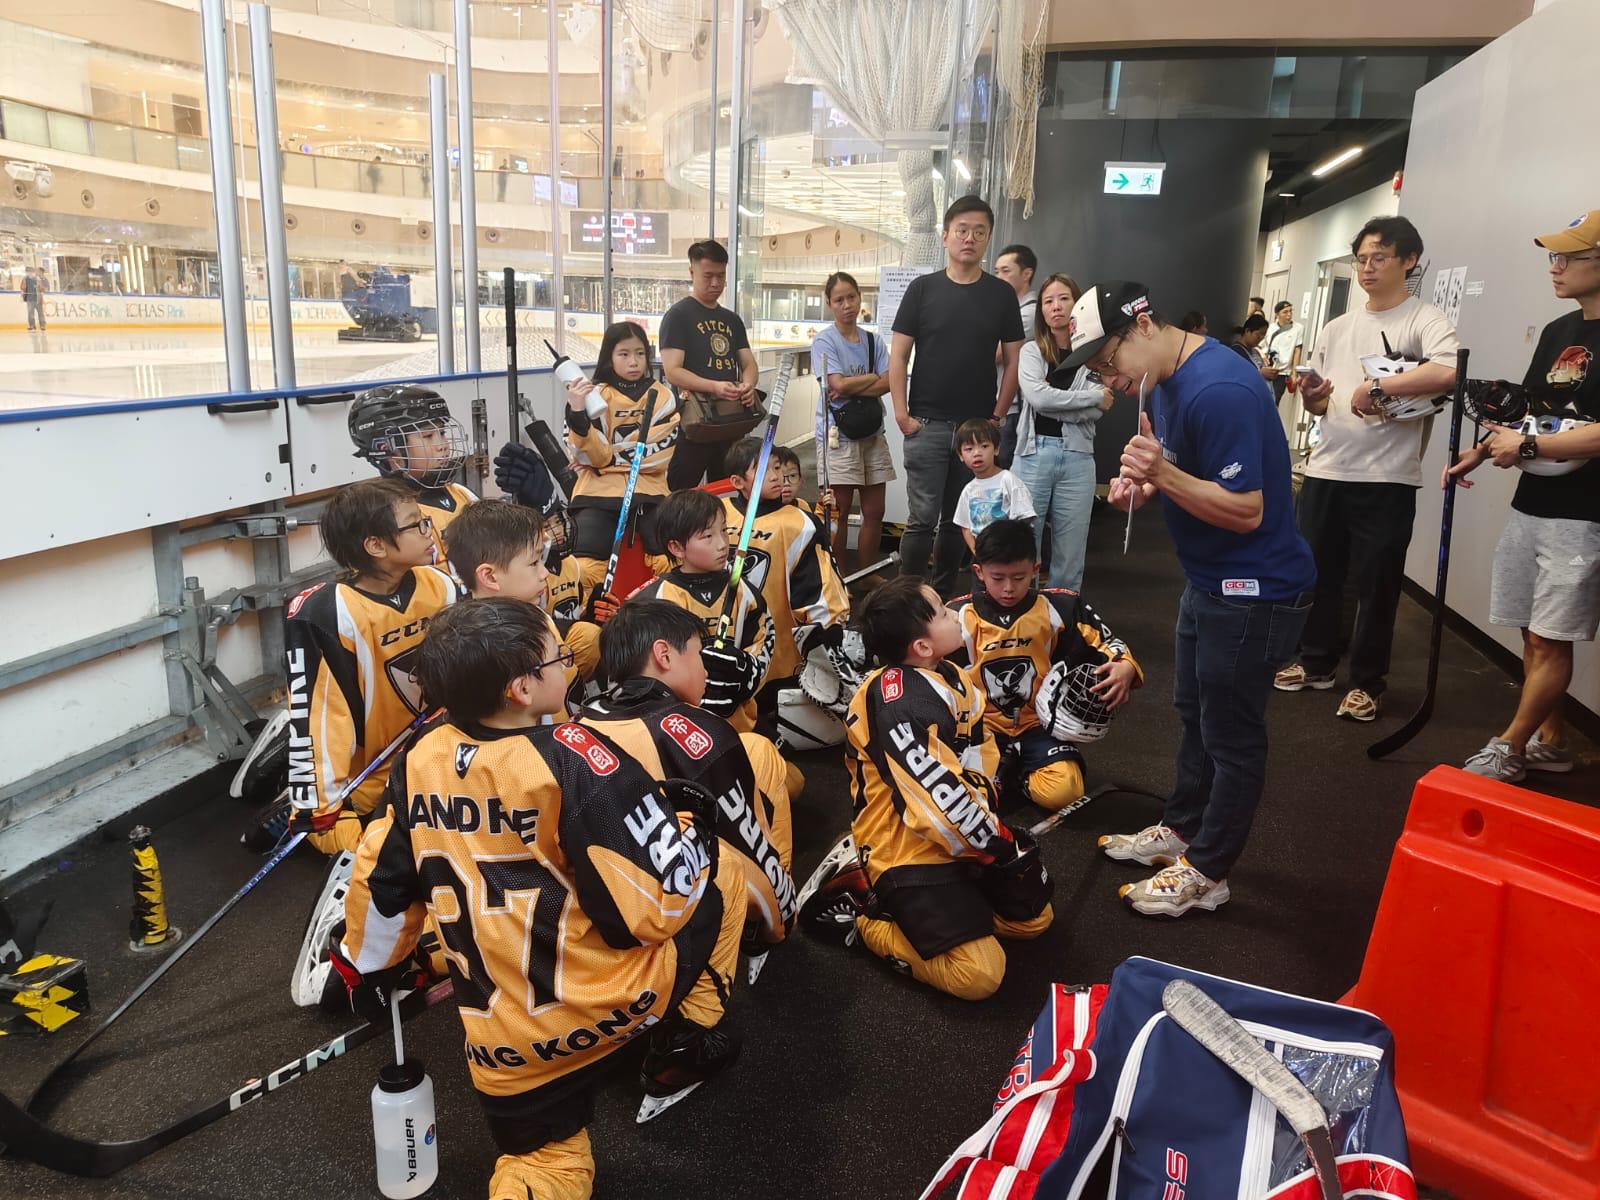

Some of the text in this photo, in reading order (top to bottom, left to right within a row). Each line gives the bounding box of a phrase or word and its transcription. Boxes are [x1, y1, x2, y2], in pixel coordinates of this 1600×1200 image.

[46, 302, 87, 317] OHAS
[696, 320, 733, 337] FITCH
[615, 410, 645, 418] CC
[359, 421, 375, 431] CCM
[551, 580, 576, 597] CCM
[983, 637, 1033, 652] CCM
[888, 721, 999, 850] EMPIRE
[531, 989, 658, 1062] KONG
[229, 1034, 346, 1111] CCM
[405, 1117, 417, 1169] BAUER
